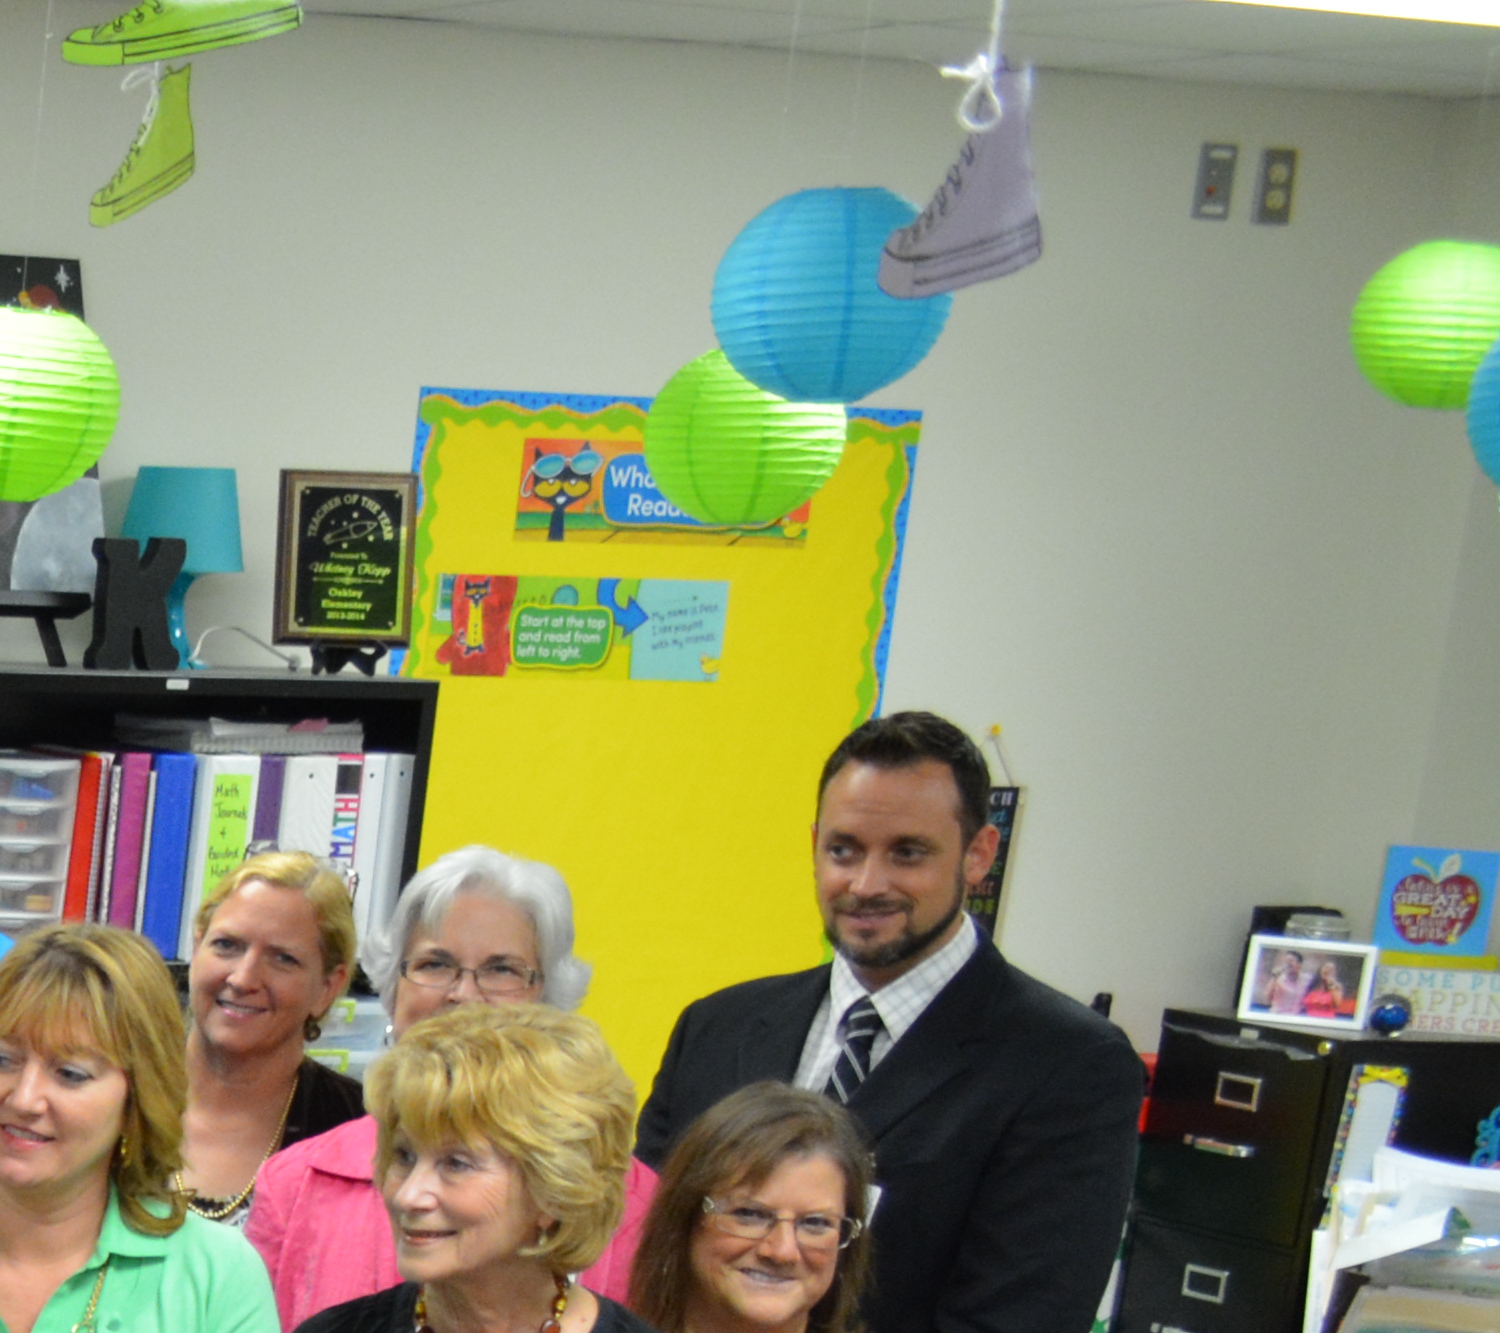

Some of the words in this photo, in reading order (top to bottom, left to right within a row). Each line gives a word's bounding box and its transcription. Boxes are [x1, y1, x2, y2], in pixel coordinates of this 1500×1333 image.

[328, 588, 363, 599] Oakley
[321, 599, 372, 612] Elementary
[520, 614, 548, 628] Start
[551, 616, 564, 628] at
[566, 615, 585, 628] the
[587, 616, 607, 630] top
[518, 631, 542, 643] and
[544, 631, 572, 644] read
[573, 631, 601, 644] from
[516, 645, 536, 658] left
[538, 646, 549, 658] to
[552, 646, 581, 662] right.
[329, 797, 361, 858] MATH
[1393, 892, 1461, 906] GREAT
[1432, 905, 1470, 919] DAY
[1377, 970, 1457, 989] SOME
